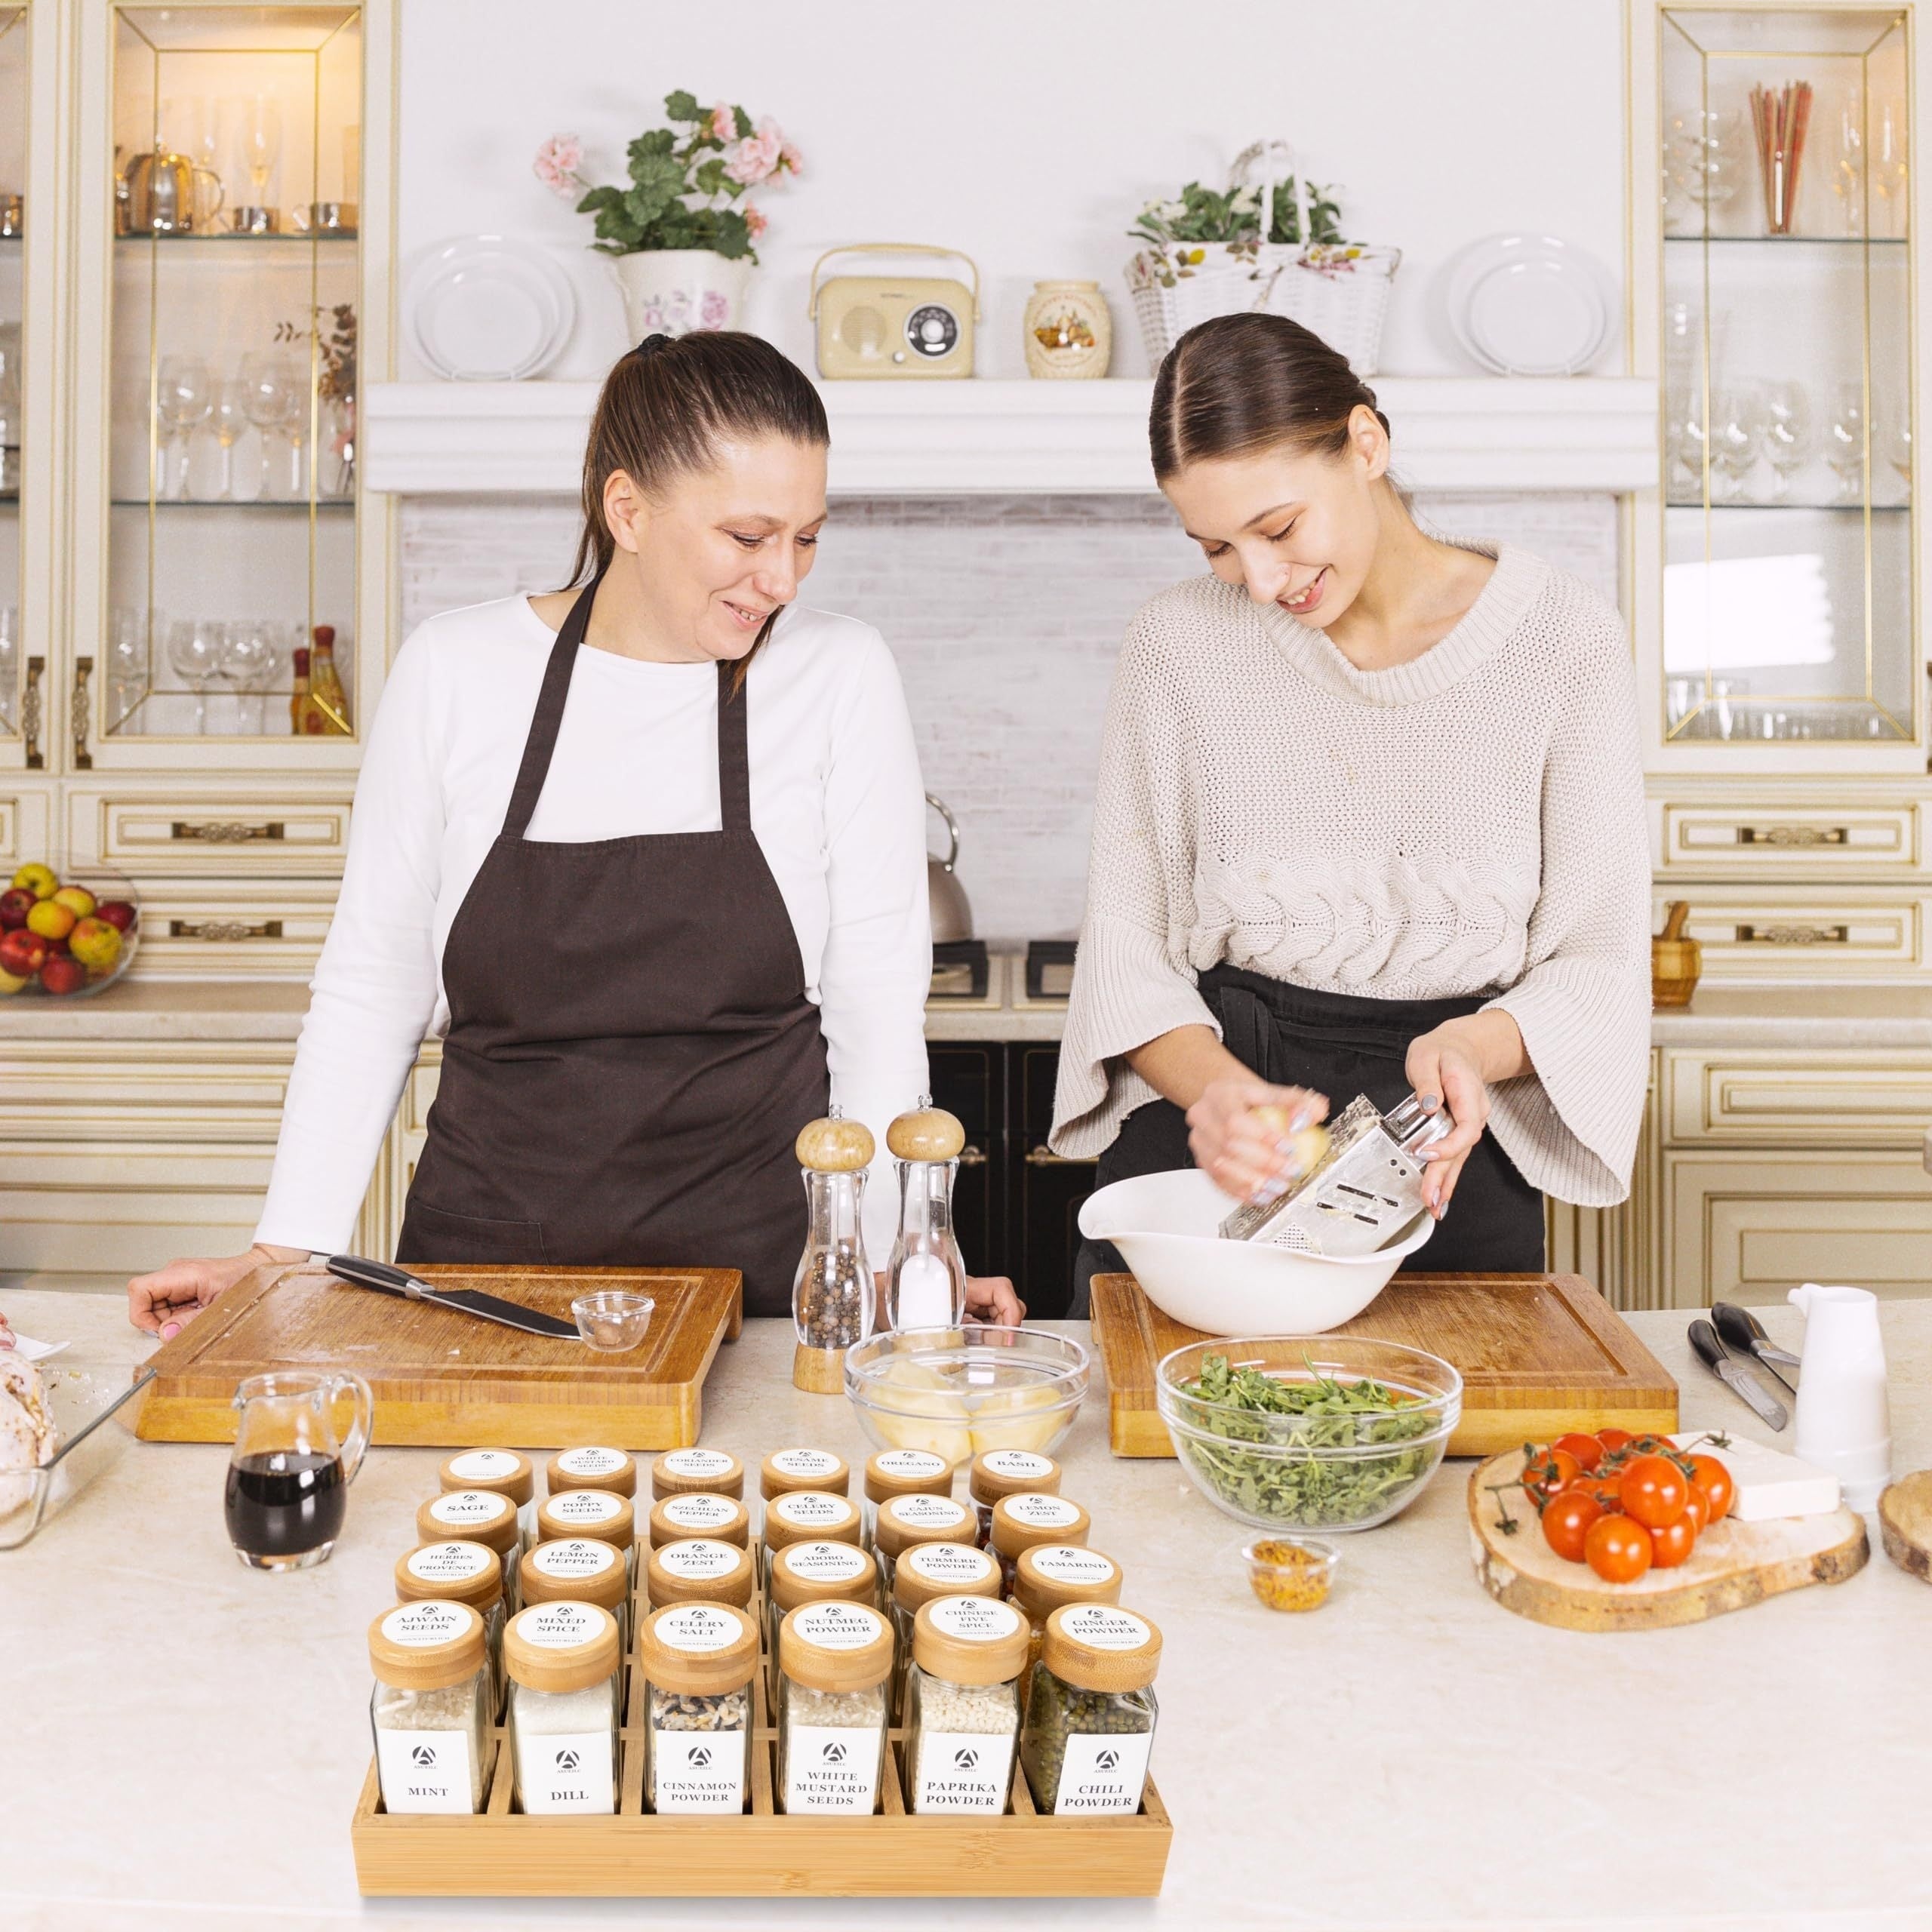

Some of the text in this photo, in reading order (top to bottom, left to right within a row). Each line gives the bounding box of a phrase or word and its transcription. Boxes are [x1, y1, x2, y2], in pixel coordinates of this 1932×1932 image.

[1038, 1561, 1107, 1569] TAMARIND
[807, 1771, 858, 1781] WHITE
[663, 1782, 737, 1790] CINNAMON
[795, 1783, 867, 1793] MUSTARD
[927, 1782, 997, 1792] PAPRIKA
[1078, 1785, 1123, 1794] CHILI
[408, 1787, 448, 1796] MINT
[551, 1790, 589, 1801] DILL
[807, 1795, 854, 1805] SEEDS
[926, 1795, 995, 1806] POWDER
[1064, 1797, 1132, 1807] POWDER
